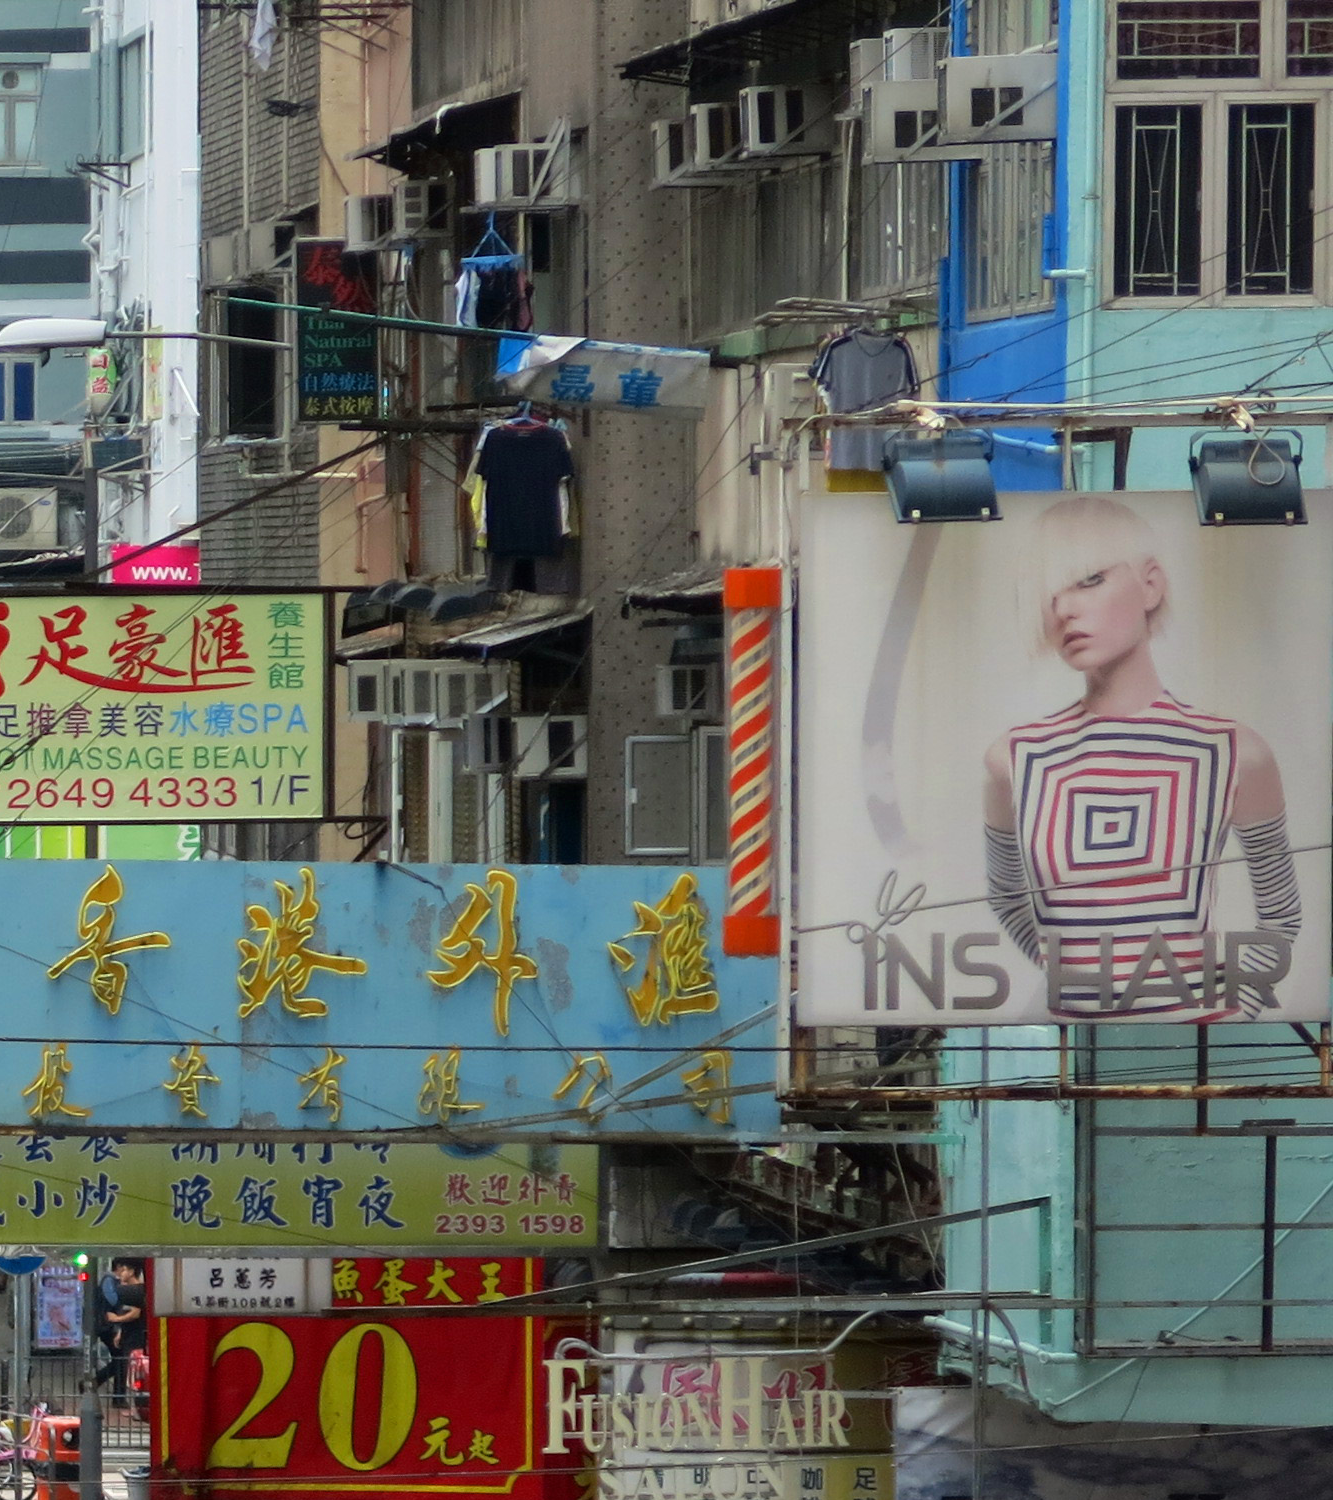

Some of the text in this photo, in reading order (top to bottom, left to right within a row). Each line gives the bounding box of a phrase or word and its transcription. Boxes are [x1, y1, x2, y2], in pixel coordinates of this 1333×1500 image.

[304, 352, 343, 368] SPA
[305, 334, 372, 350] Natural
[305, 372, 374, 393] 自然療法
[132, 564, 197, 580] www.
[19, 602, 256, 693] 足豪匯
[267, 601, 305, 689] 養生館
[43, 747, 186, 770] MASSAGE
[192, 745, 308, 769] BEAUTY
[8, 775, 311, 808] 2649 4333 1/F
[864, 927, 1291, 1011] INS HAIR
[22, 1043, 731, 1122] 投資有限公司
[171, 1174, 406, 1229] 晚飯宵夜
[436, 1214, 584, 1235] 2393 1598
[333, 1260, 506, 1306] 魚蛋大王
[207, 1322, 499, 1471] 20 元起
